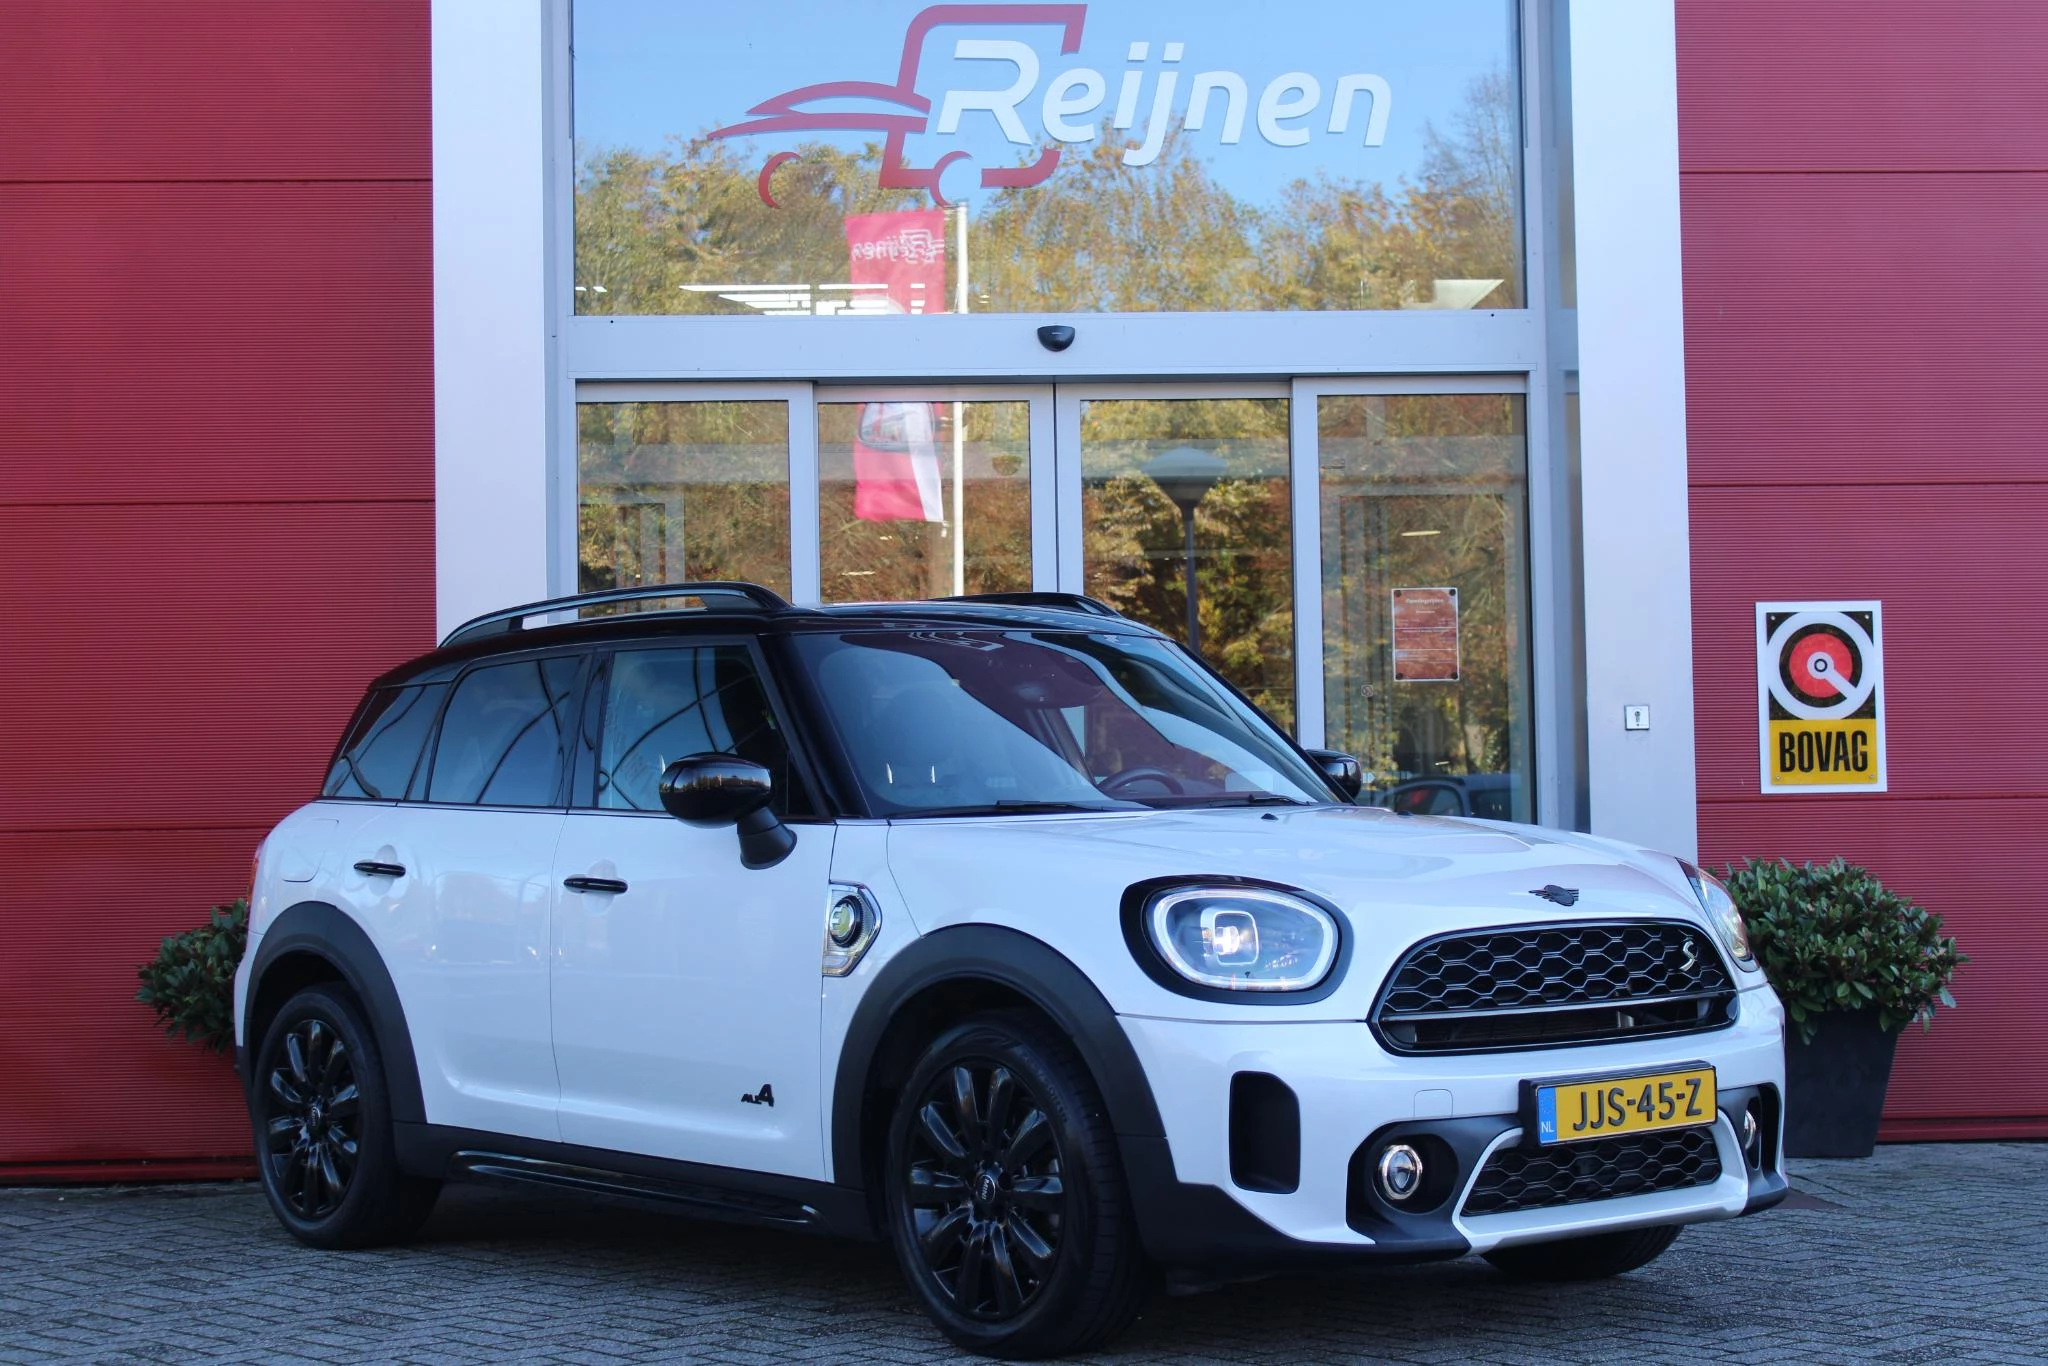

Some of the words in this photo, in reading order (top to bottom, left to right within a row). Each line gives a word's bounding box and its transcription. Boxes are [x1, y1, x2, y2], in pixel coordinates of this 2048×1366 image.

[937, 40, 1393, 167] Reijnen
[1779, 730, 1868, 772] BOVAG
[1541, 1122, 1554, 1133] NL
[1573, 1078, 1702, 1131] JJS-45-Z
